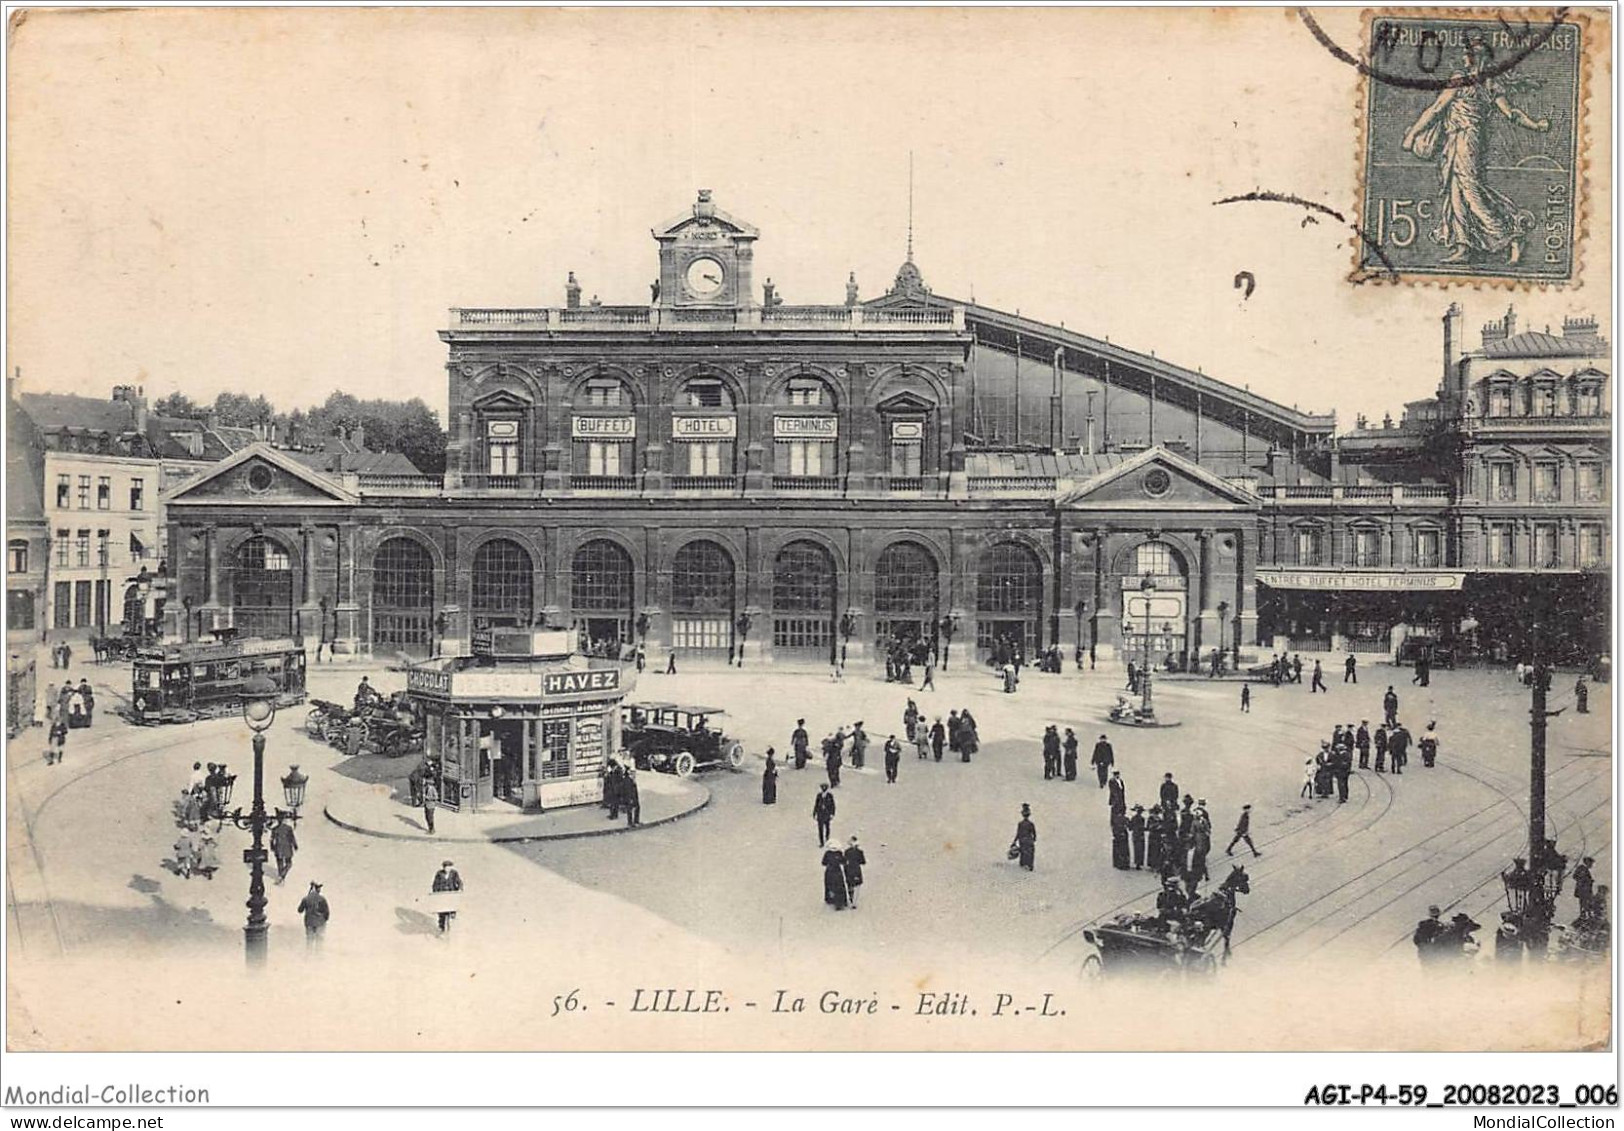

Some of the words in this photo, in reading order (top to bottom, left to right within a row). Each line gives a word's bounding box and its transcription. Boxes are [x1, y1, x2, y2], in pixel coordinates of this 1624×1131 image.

[1544, 183, 1566, 264] POSTES
[580, 418, 626, 432] BUFFET
[685, 418, 724, 432] HOTEL
[780, 418, 832, 432] TERMINUS
[1352, 576, 1381, 588] HOTEL
[1388, 576, 1436, 588] TERMINUS
[409, 671, 449, 690] CHOCOLAT
